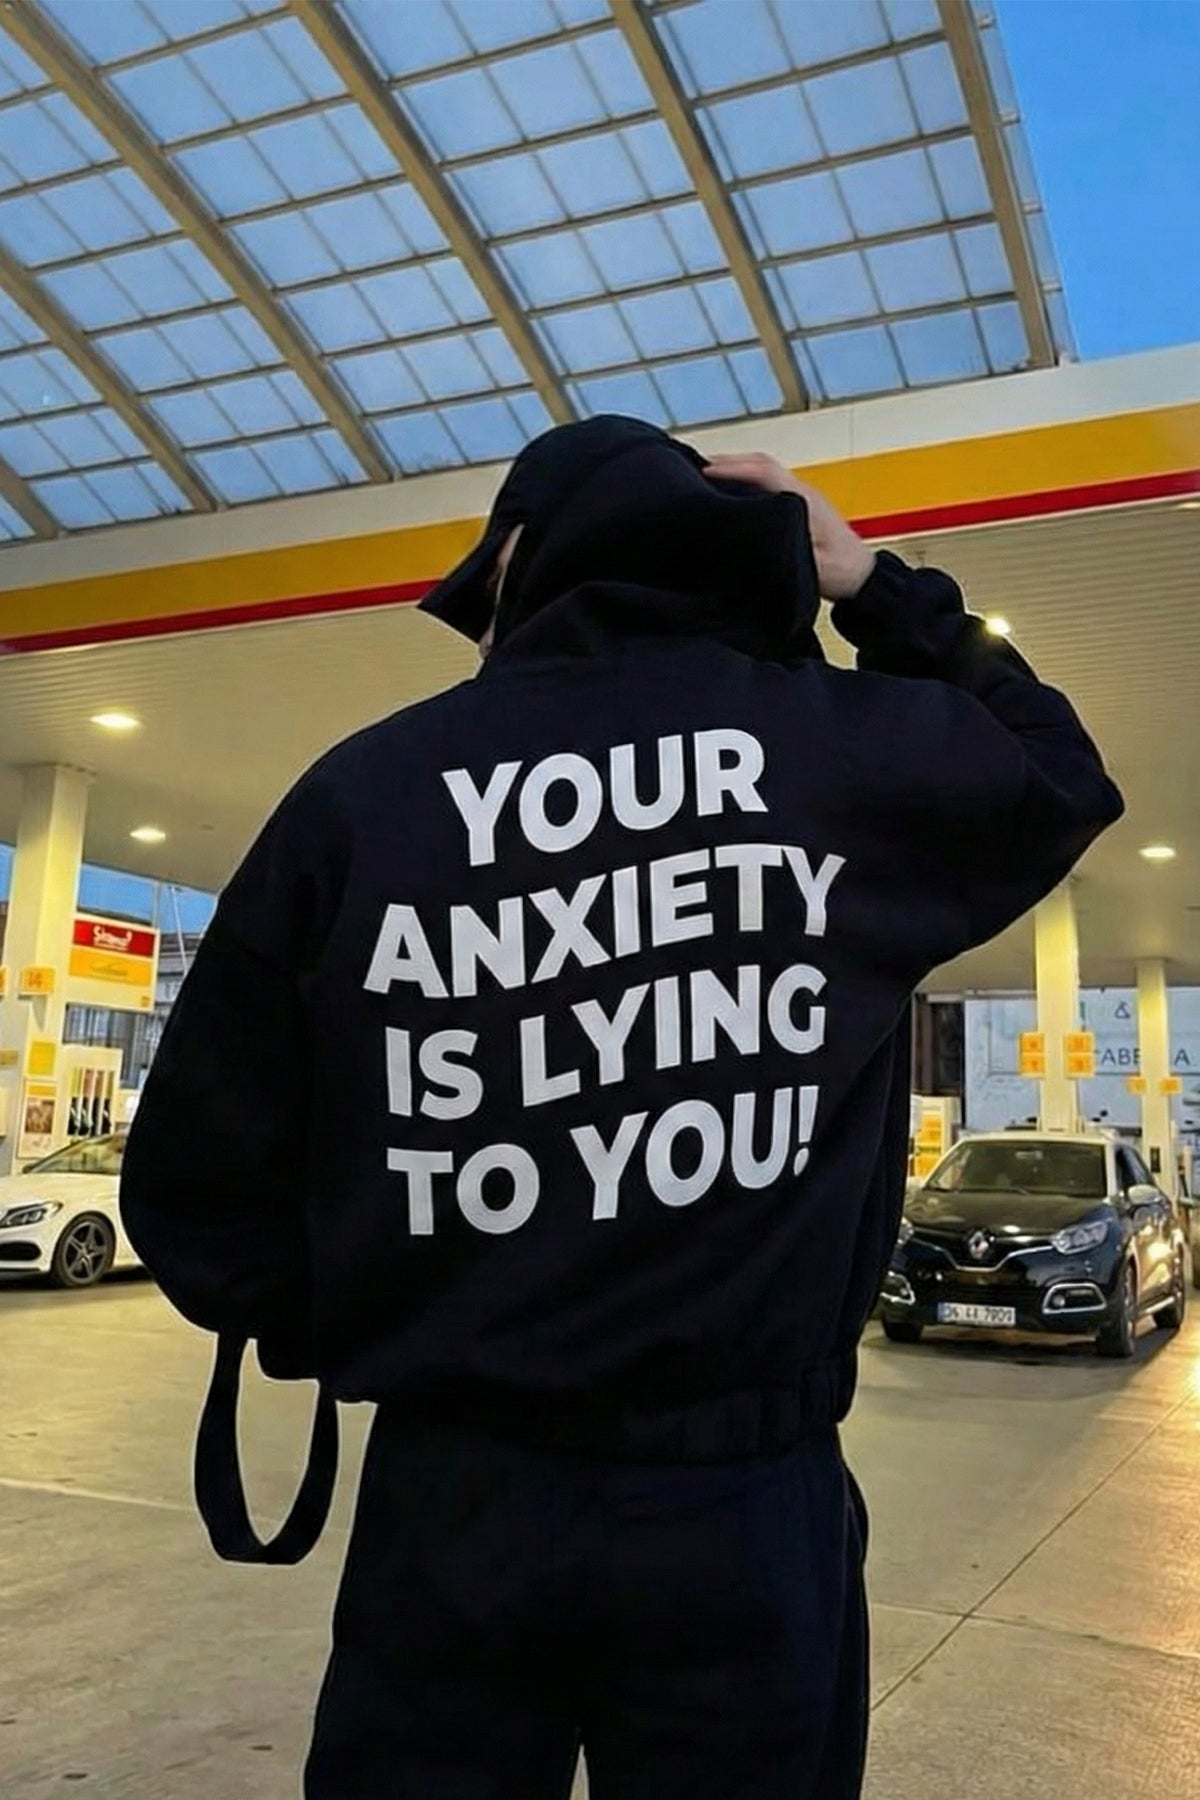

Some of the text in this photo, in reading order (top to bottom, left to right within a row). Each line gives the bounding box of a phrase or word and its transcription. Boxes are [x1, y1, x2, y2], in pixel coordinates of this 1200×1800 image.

[442, 729, 768, 867] YOUR
[363, 844, 847, 999] ANXIETY
[386, 964, 828, 1120] IS LYING
[387, 1085, 820, 1235] TO YOU!
